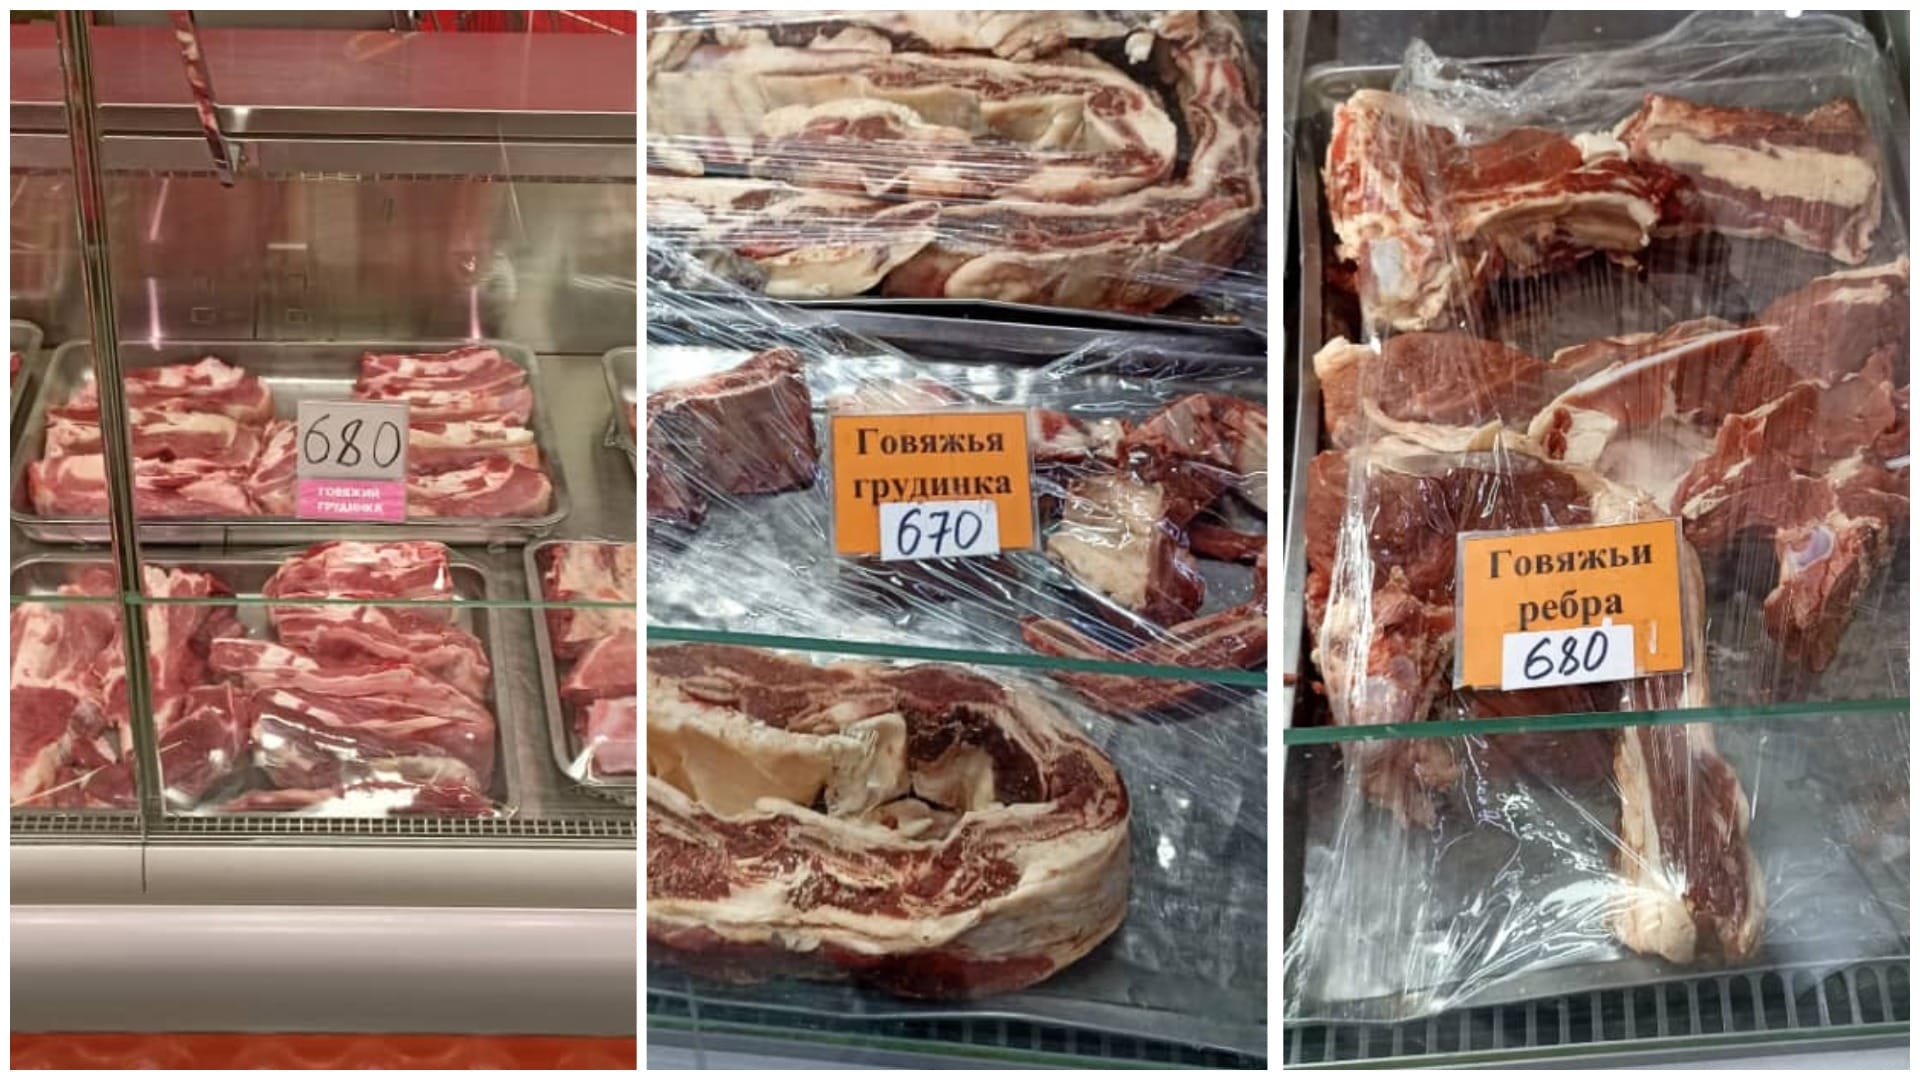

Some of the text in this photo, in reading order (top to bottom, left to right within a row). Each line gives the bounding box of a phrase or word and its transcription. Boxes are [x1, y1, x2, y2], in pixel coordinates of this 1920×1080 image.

[304, 413, 401, 468] 680
[857, 428, 1004, 455] Говяжья
[317, 501, 384, 513] ГРУДИНКА
[854, 475, 1012, 505] грудинка
[897, 508, 982, 555] 670
[1489, 544, 1653, 579] Говяжьи
[1518, 590, 1624, 631] ребра
[1524, 631, 1609, 680] 680
